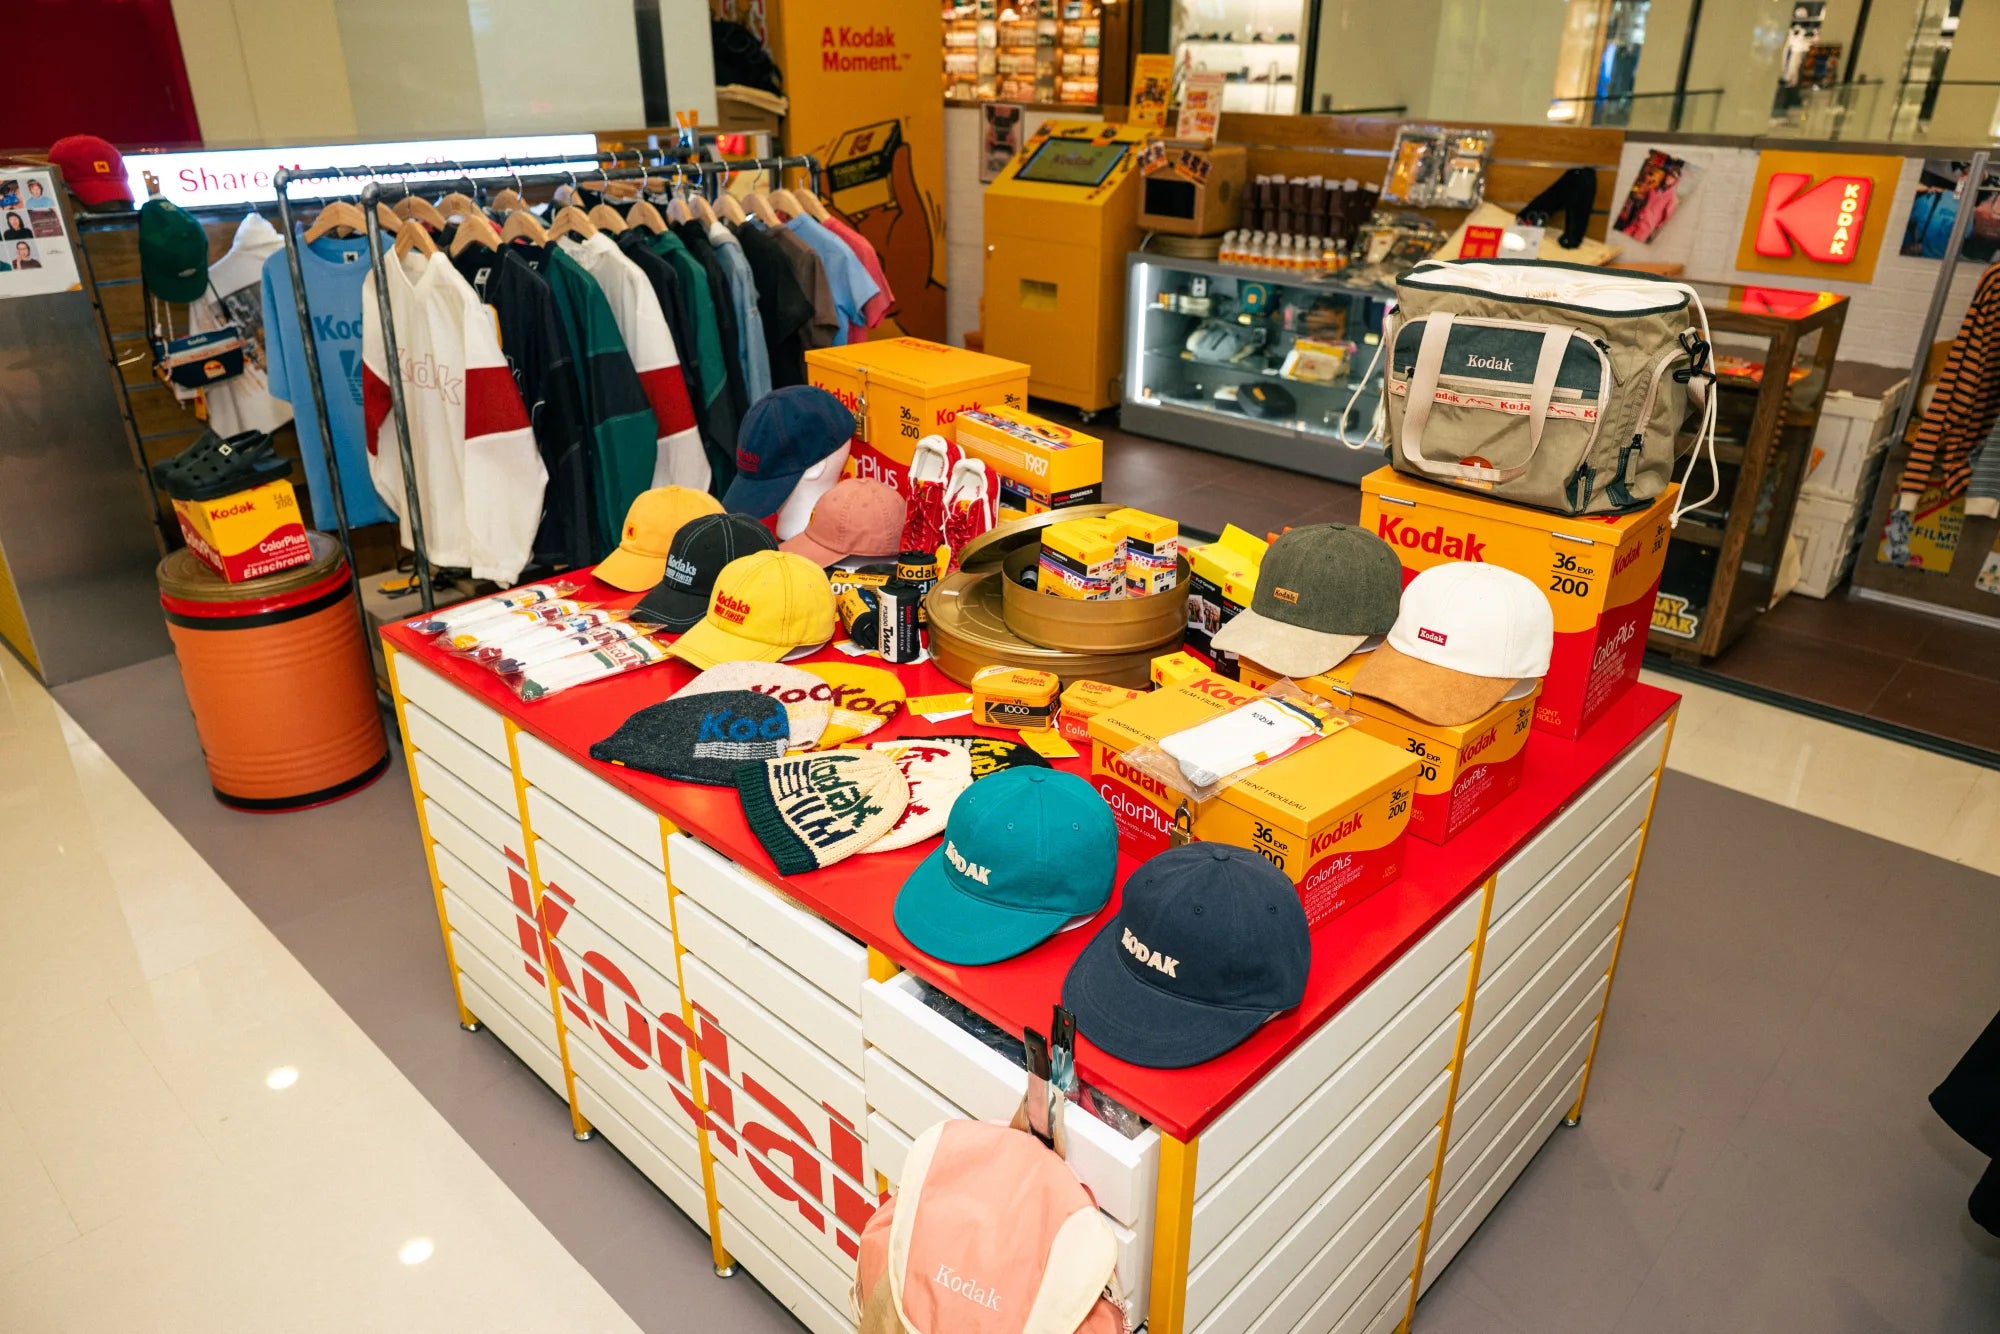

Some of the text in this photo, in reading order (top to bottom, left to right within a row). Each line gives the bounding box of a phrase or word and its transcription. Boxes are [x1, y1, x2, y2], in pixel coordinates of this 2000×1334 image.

[822, 26, 895, 47] A Kodak
[822, 53, 902, 72] Moment.
[179, 167, 268, 192] Share
[1830, 184, 1861, 255] KODAK
[1466, 354, 1514, 372] Kodak
[900, 406, 911, 420] 36
[901, 424, 920, 440] 200
[1024, 452, 1048, 477] 1987
[211, 501, 255, 521] Kodak
[260, 533, 306, 553] ColorPlus
[1378, 513, 1486, 562] Kodak
[243, 554, 311, 579] Ektachrome
[1129, 552, 1153, 570] 1987
[1552, 552, 1577, 571] 36
[1612, 540, 1642, 579] Kodak
[898, 566, 937, 579] Kodak
[1063, 568, 1085, 591] 1987
[1550, 575, 1589, 597] 200
[716, 590, 751, 614] Kodak's
[1418, 628, 1446, 645] Kodak
[1082, 681, 1113, 692] Kodak
[1004, 705, 1030, 715] 1000
[1406, 738, 1426, 757] 36
[1458, 728, 1498, 768] Kodak
[1453, 766, 1488, 798] ColorPlus
[1269, 791, 1306, 811] ROULEAU
[1391, 788, 1402, 803] 36
[1387, 801, 1407, 820] 200
[1252, 821, 1273, 844] 36
[1310, 812, 1363, 858] Kodak
[945, 840, 991, 886] KODAK
[1306, 854, 1352, 891] ColorPlus
[1122, 927, 1180, 979] KODAK
[933, 1264, 1002, 1312] Kodak
